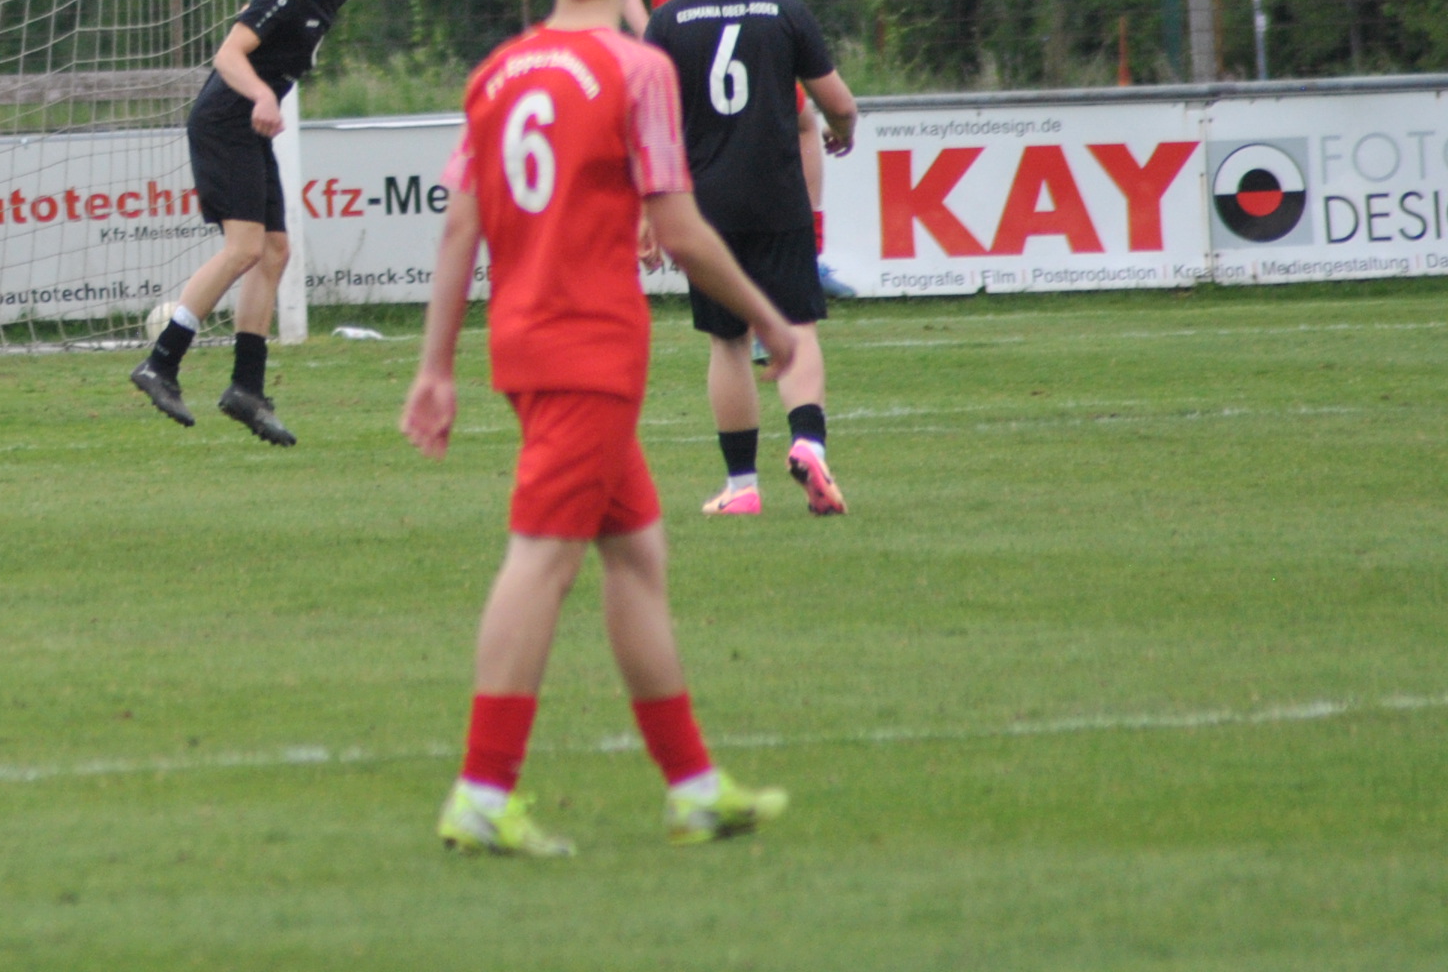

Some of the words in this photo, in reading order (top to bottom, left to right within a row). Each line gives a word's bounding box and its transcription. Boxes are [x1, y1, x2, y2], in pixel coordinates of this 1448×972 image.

[709, 24, 749, 116] 6
[503, 89, 555, 214] 6
[876, 118, 1062, 140] www.kayfotodesign.de
[1320, 129, 1448, 185] FOT
[301, 175, 450, 219] Kfz-Me
[877, 141, 1201, 260] KAY
[1323, 189, 1448, 245] DESI
[305, 268, 433, 288] ax-Planck-Str
[880, 271, 965, 290] Fotografie
[981, 268, 1017, 284] Film
[1032, 264, 1157, 286] Postproduction
[1173, 262, 1245, 280] Kreation
[1261, 256, 1410, 277] Mediengestaltung
